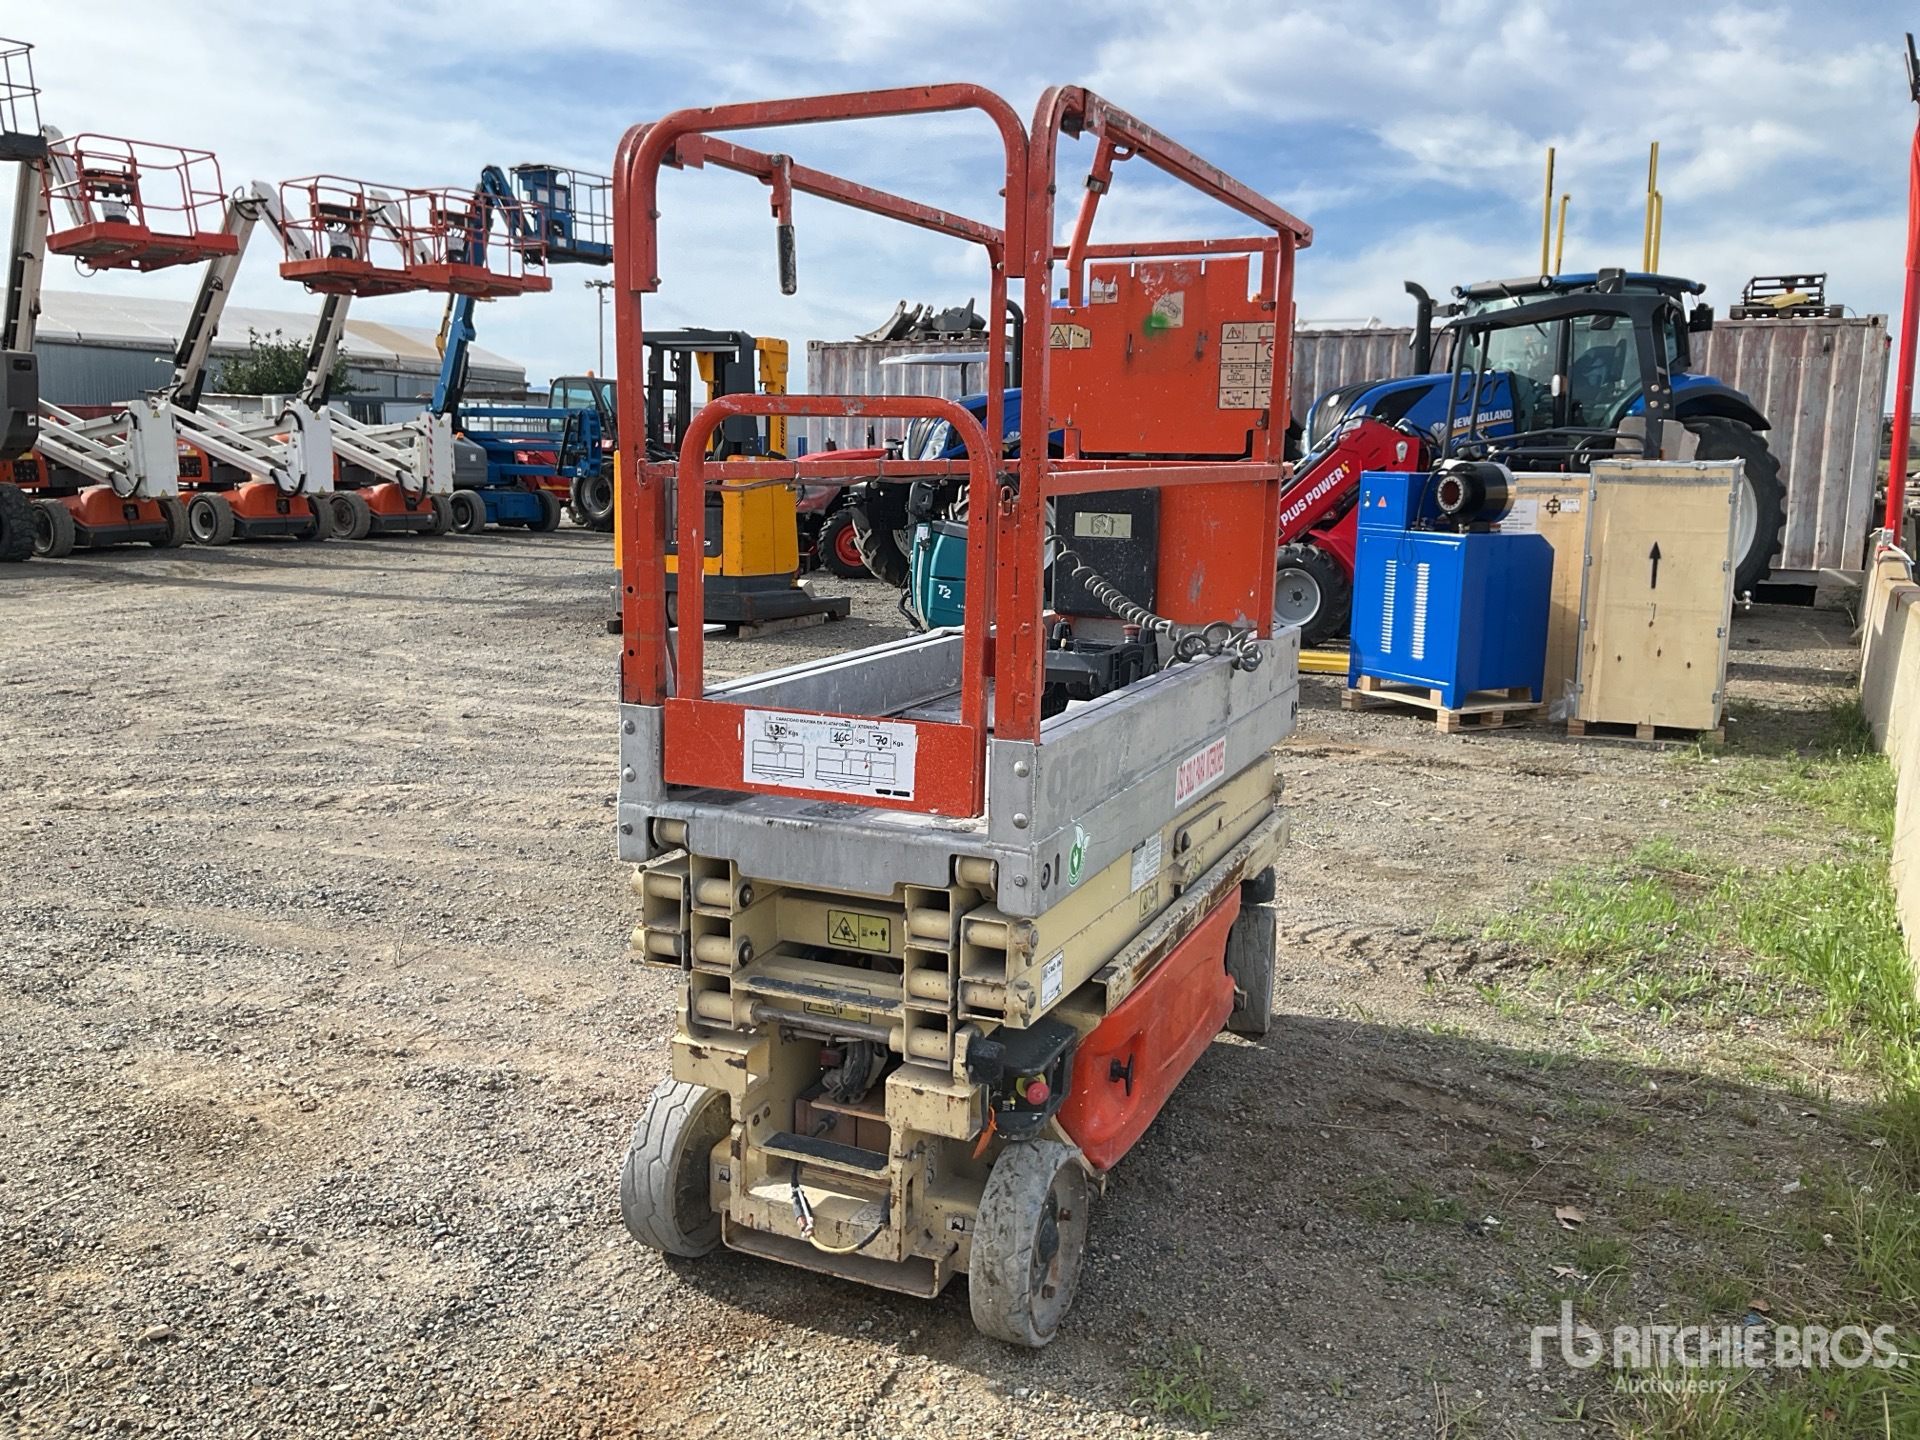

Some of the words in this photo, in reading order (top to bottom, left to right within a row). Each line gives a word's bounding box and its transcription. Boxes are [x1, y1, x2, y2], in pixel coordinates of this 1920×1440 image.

[1280, 498, 1307, 526] PLUS
[1305, 467, 1344, 505] POWER
[938, 584, 951, 599] T2
[872, 734, 888, 745] 70
